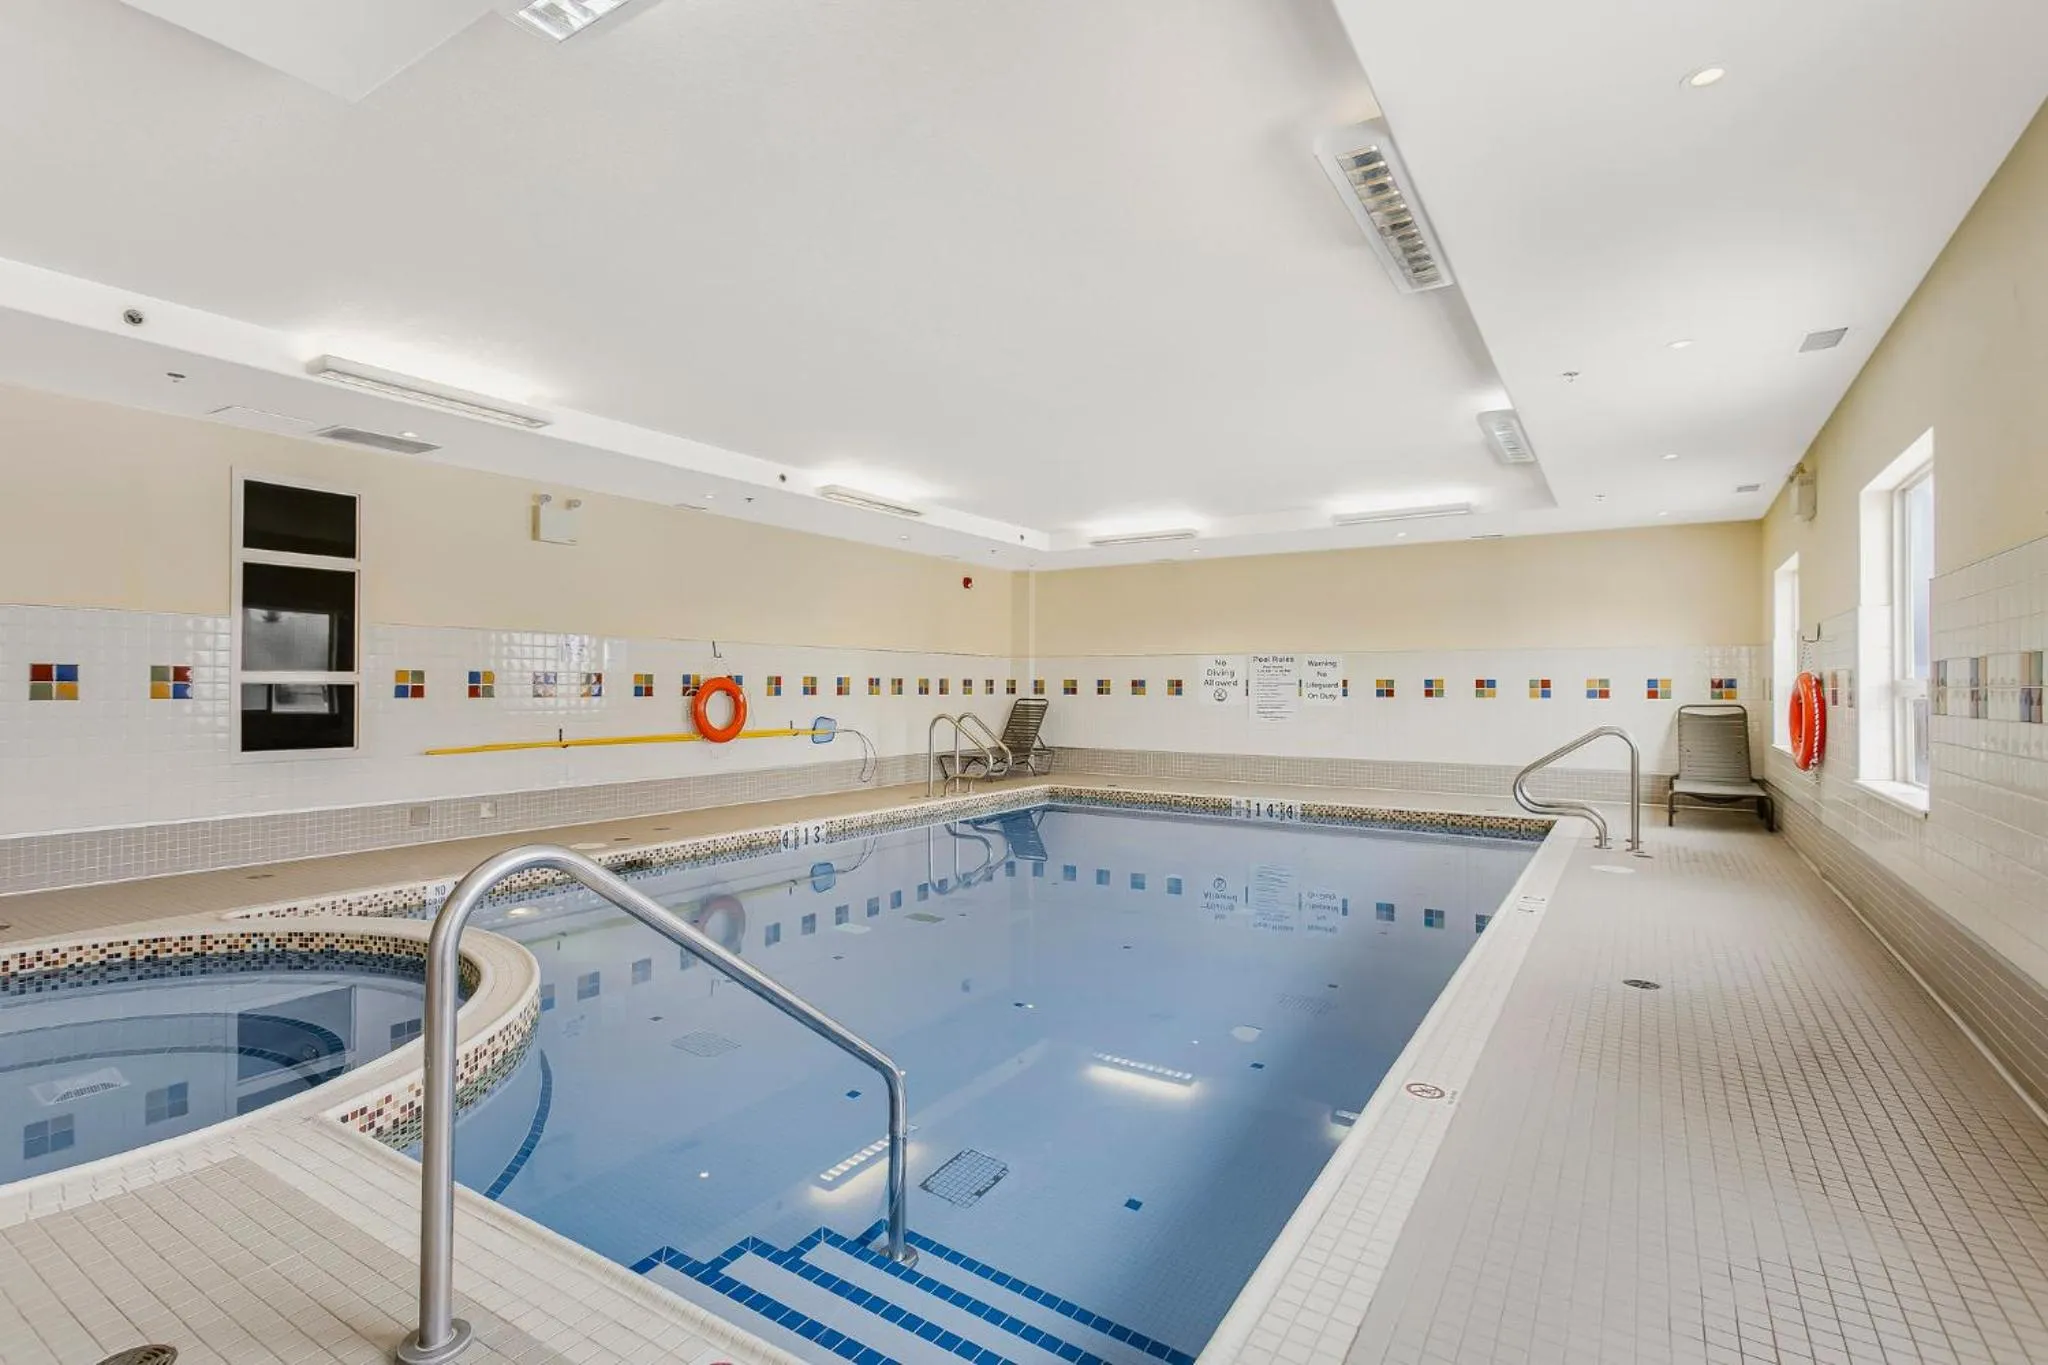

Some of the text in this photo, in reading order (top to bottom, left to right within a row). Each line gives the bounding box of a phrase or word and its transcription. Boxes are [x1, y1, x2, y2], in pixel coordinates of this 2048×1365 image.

[1307, 659, 1338, 668] Warning
[1206, 668, 1235, 679] Diving
[1203, 679, 1238, 687] Allowed
[1306, 681, 1339, 690] Lifeguard
[1320, 692, 1337, 701] Duty
